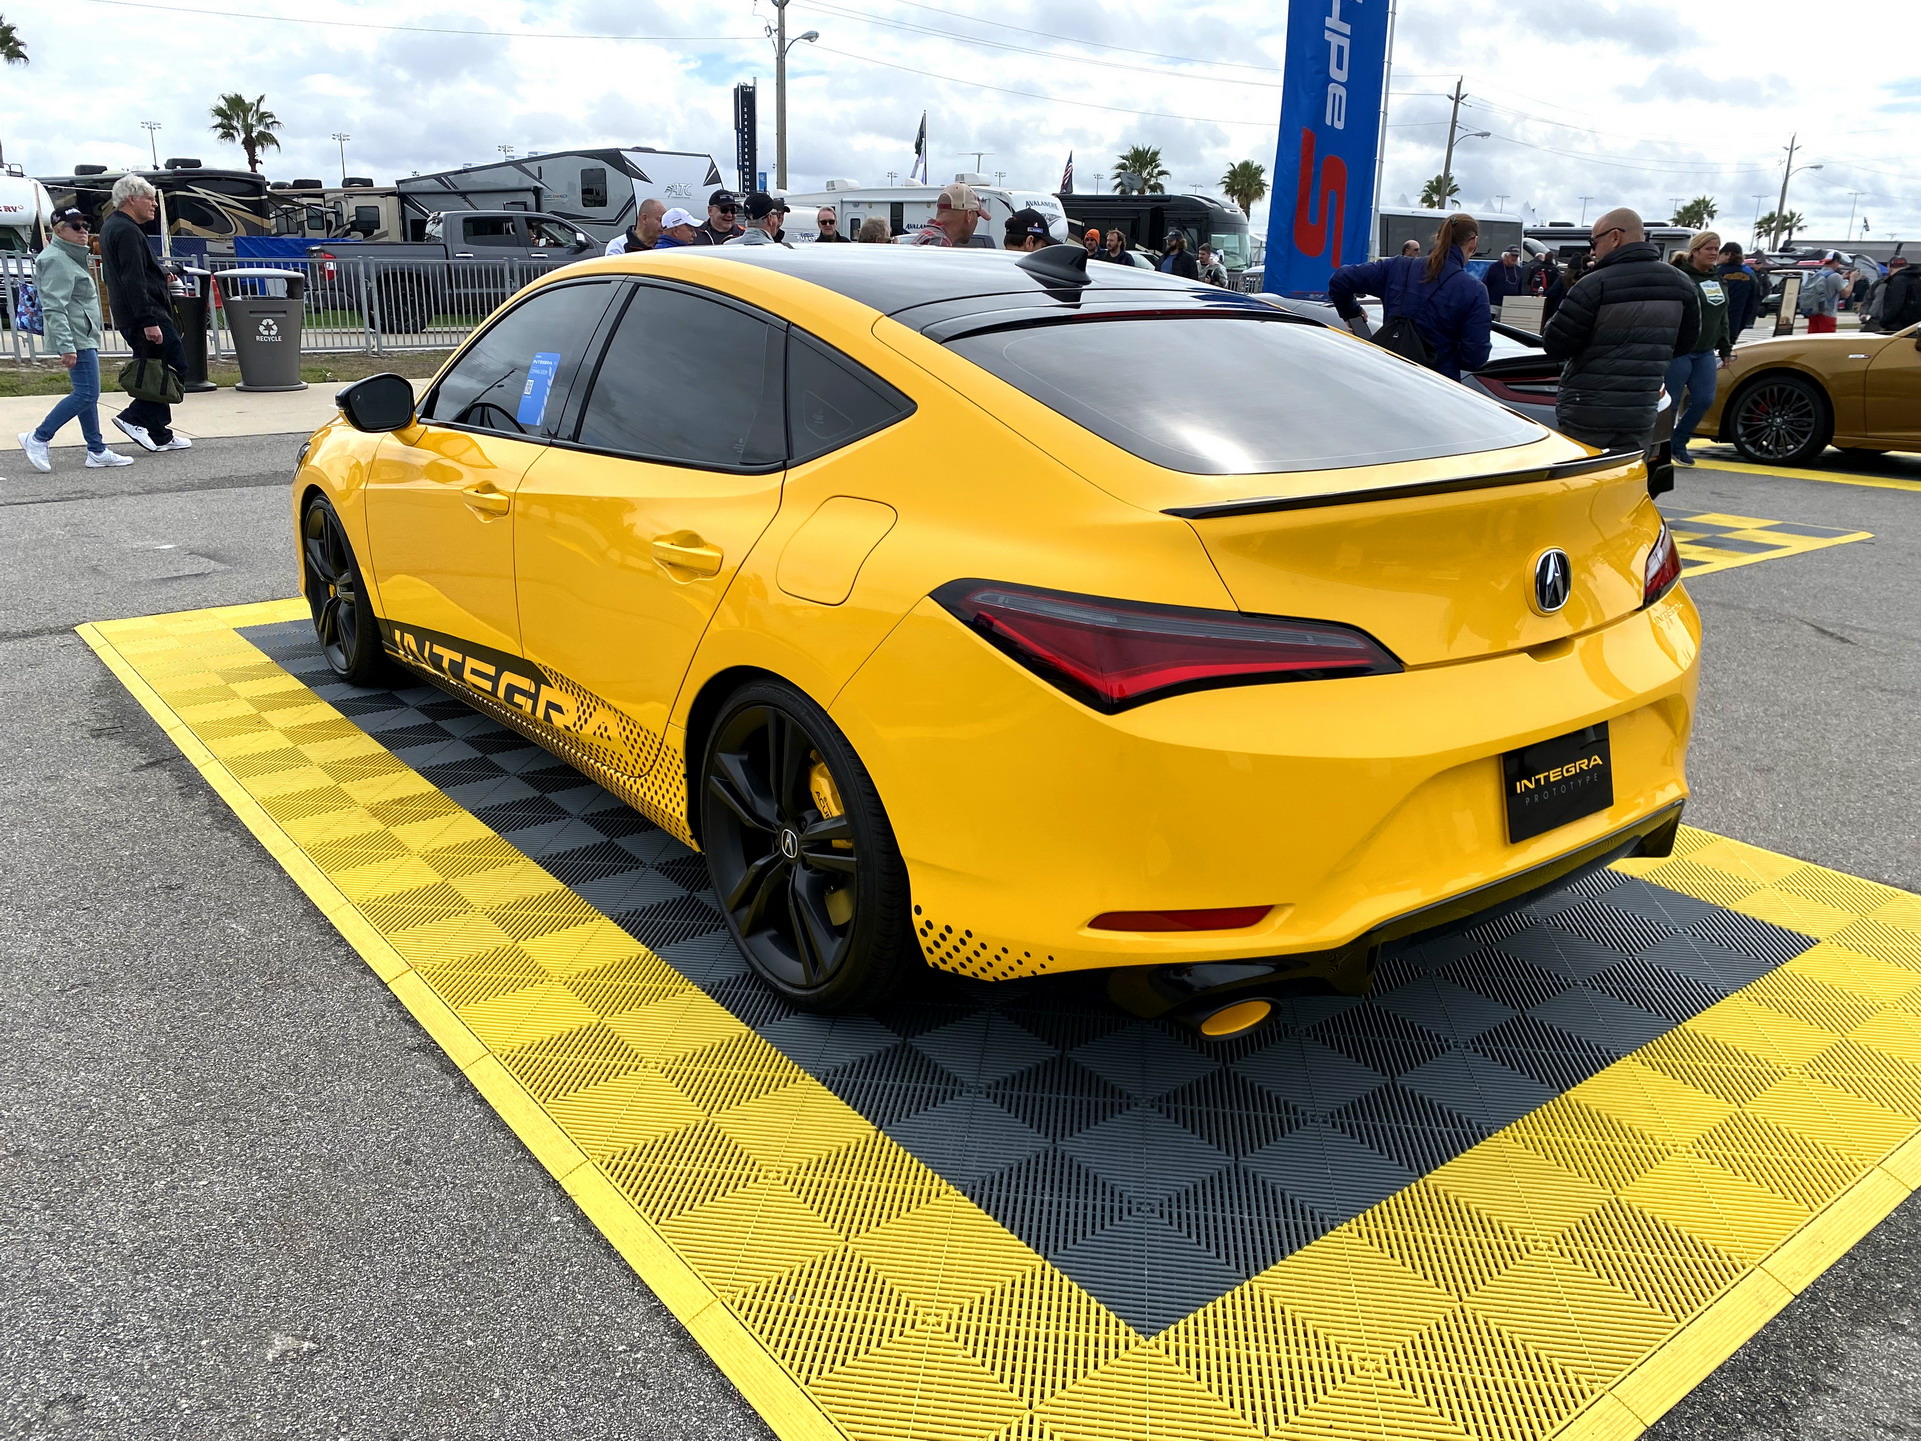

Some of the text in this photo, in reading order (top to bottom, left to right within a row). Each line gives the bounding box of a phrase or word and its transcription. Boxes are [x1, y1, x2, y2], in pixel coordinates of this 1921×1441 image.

[1293, 0, 1358, 270] ype S
[3, 205, 18, 213] RV
[394, 628, 632, 750] INTEGRA
[1516, 755, 1603, 794] INTEGRA
[1525, 773, 1598, 806] PROTOTYPE
[815, 791, 831, 819] ACUR
